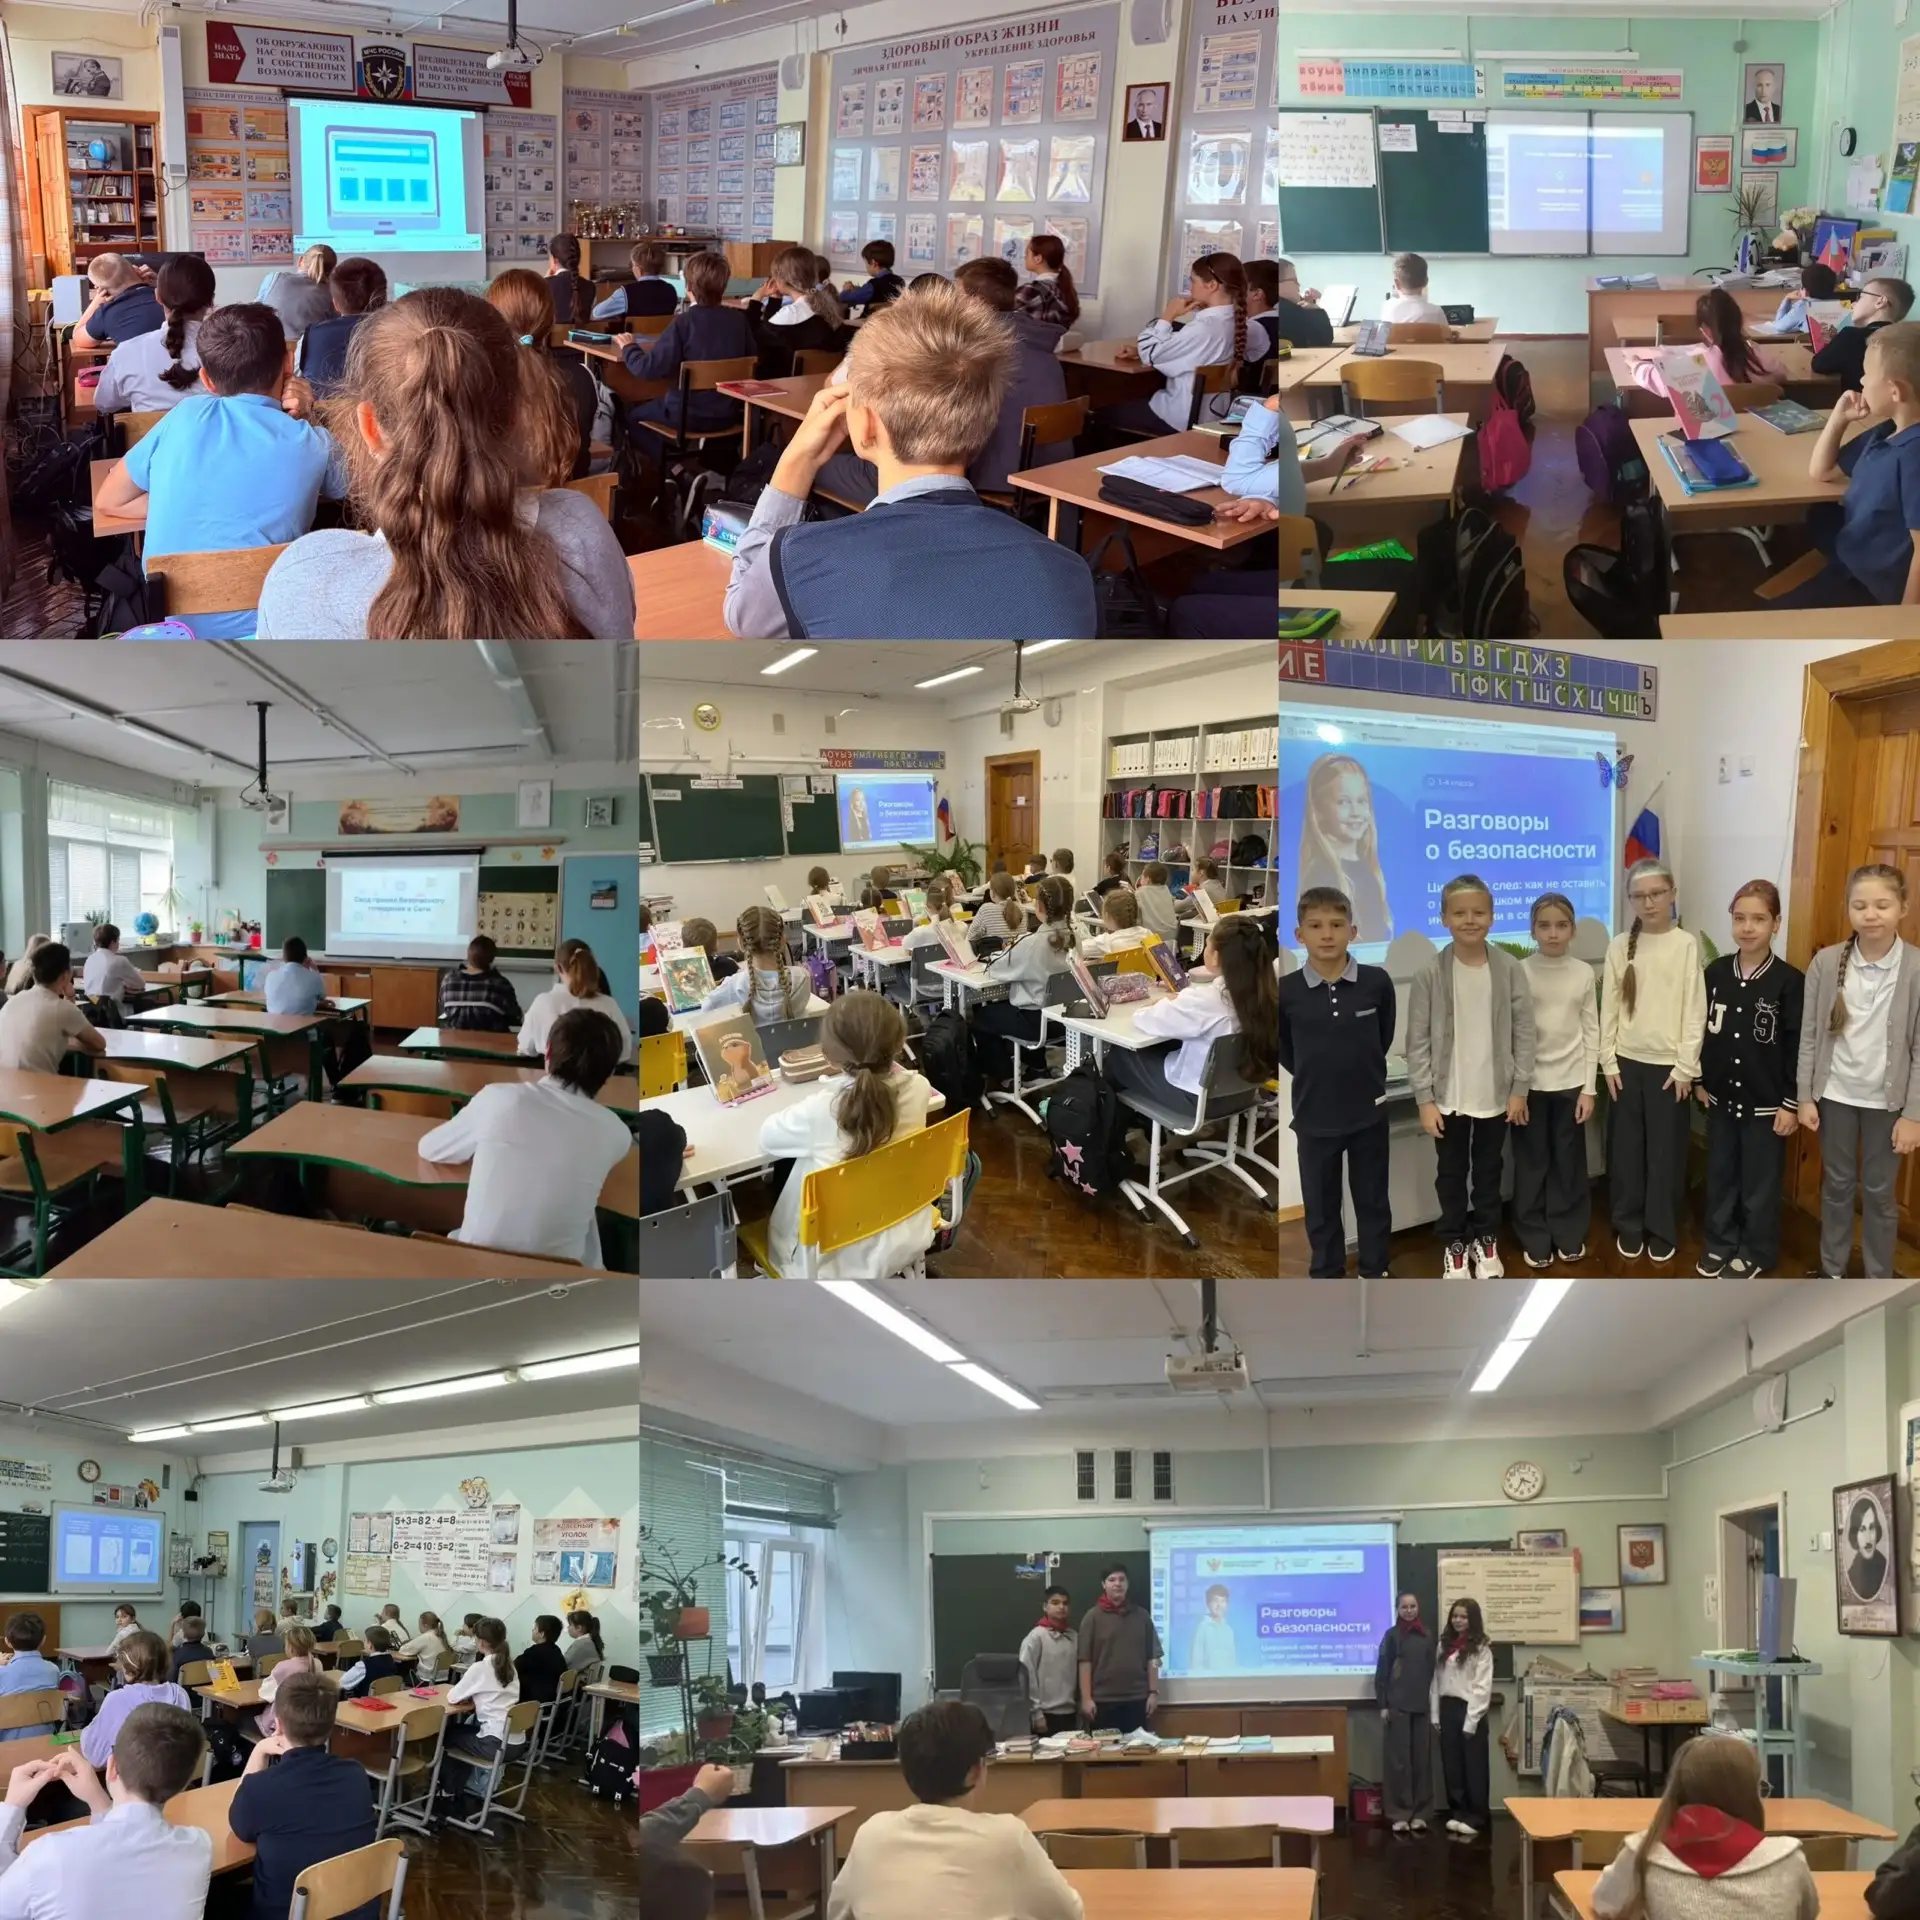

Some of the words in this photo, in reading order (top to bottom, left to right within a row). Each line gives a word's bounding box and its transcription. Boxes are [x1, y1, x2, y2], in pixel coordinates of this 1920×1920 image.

[1217, 14, 1237, 25] НА
[881, 37, 950, 59] ЗДОРОВЫЙ
[954, 29, 998, 47] ОБРАЗ
[1002, 19, 1060, 39] ЖИЗНИ
[964, 39, 1033, 59] УКРЕПЛЕНИЕ
[1036, 31, 1096, 49] ЗДОРОВЬЯ
[214, 43, 240, 52] НАДО
[256, 38, 270, 46] ОБ
[272, 39, 345, 53] ОКРУЖАЮЩИХ
[213, 52, 241, 60] ЗНАТЬ
[257, 48, 276, 56] НАС
[281, 50, 346, 62] ОПАСНОСТЯХ
[378, 48, 404, 58] РОССИИ
[257, 57, 264, 65] И
[271, 59, 346, 72] СОБСТВЕННЫХ
[852, 64, 884, 75] ЛИЧНАЯ
[886, 58, 926, 72] ГИГИЕНА
[257, 67, 346, 81] ВОЗМОЖНОСТЯХ
[456, 68, 502, 78] ОПАСНОСТИ
[419, 81, 456, 91] ИЗБЕГАТЬ
[444, 75, 502, 87] ВОЗМОЖНОСТИ
[1424, 808, 1549, 835] Разговоры
[1425, 843, 1440, 860] о
[1448, 840, 1596, 861] безопасности
[1492, 880, 1523, 891] след:
[1525, 881, 1543, 889] как
[1546, 880, 1560, 889] не
[1561, 879, 1606, 888] оставить
[1507, 913, 1515, 921] в
[1707, 1003, 1728, 1034] J
[394, 1516, 424, 1525] 5+3=8
[393, 1541, 422, 1550] 6-2=4
[1261, 1607, 1337, 1619] Разговоры
[1261, 1625, 1270, 1634] о
[1273, 1622, 1371, 1634] безопасности
